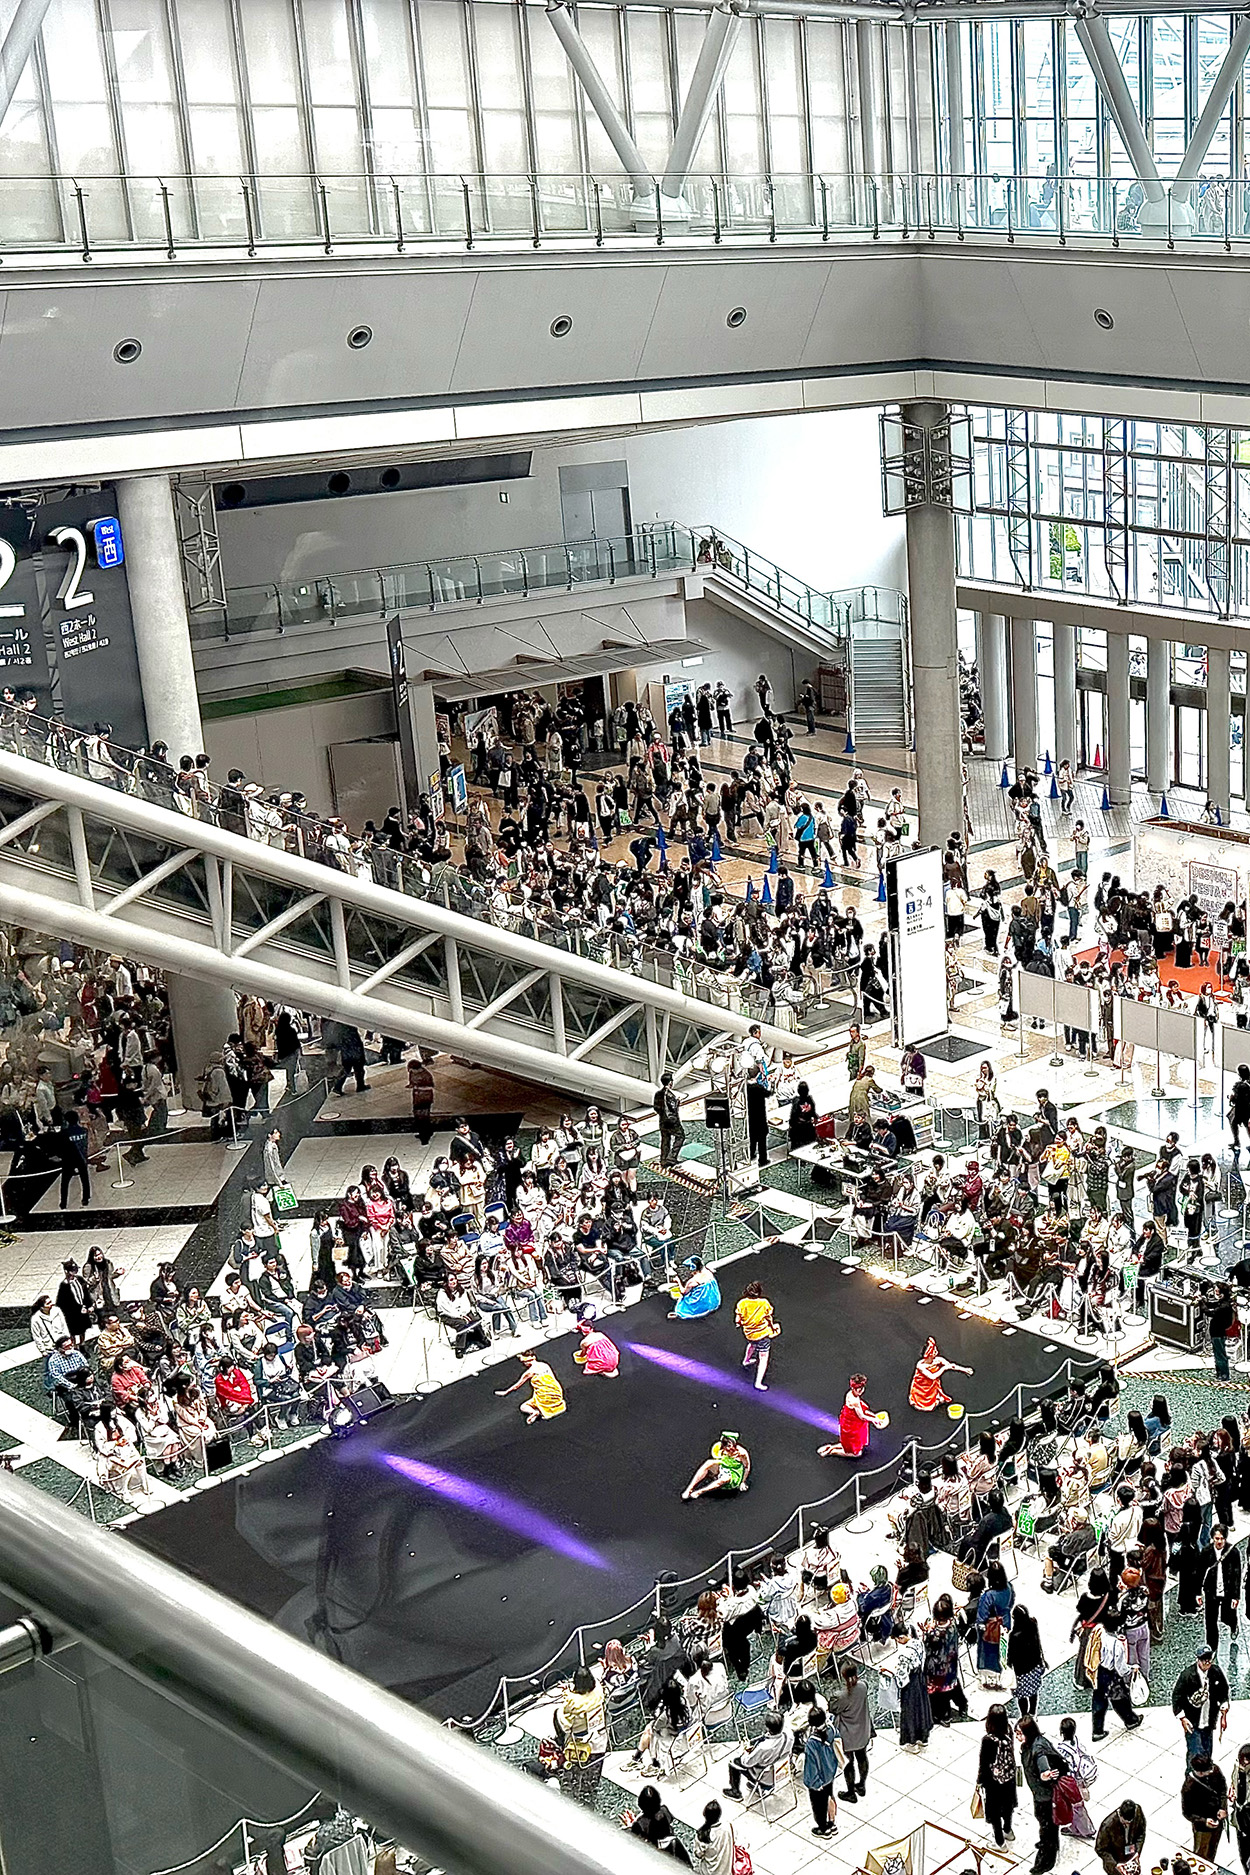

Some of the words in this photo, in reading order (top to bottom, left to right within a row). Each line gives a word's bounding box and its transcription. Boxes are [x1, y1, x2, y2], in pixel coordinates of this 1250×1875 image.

[103, 536, 118, 564] 西
[57, 527, 94, 610] 2
[91, 628, 97, 640] 2
[22, 643, 31, 654] 2
